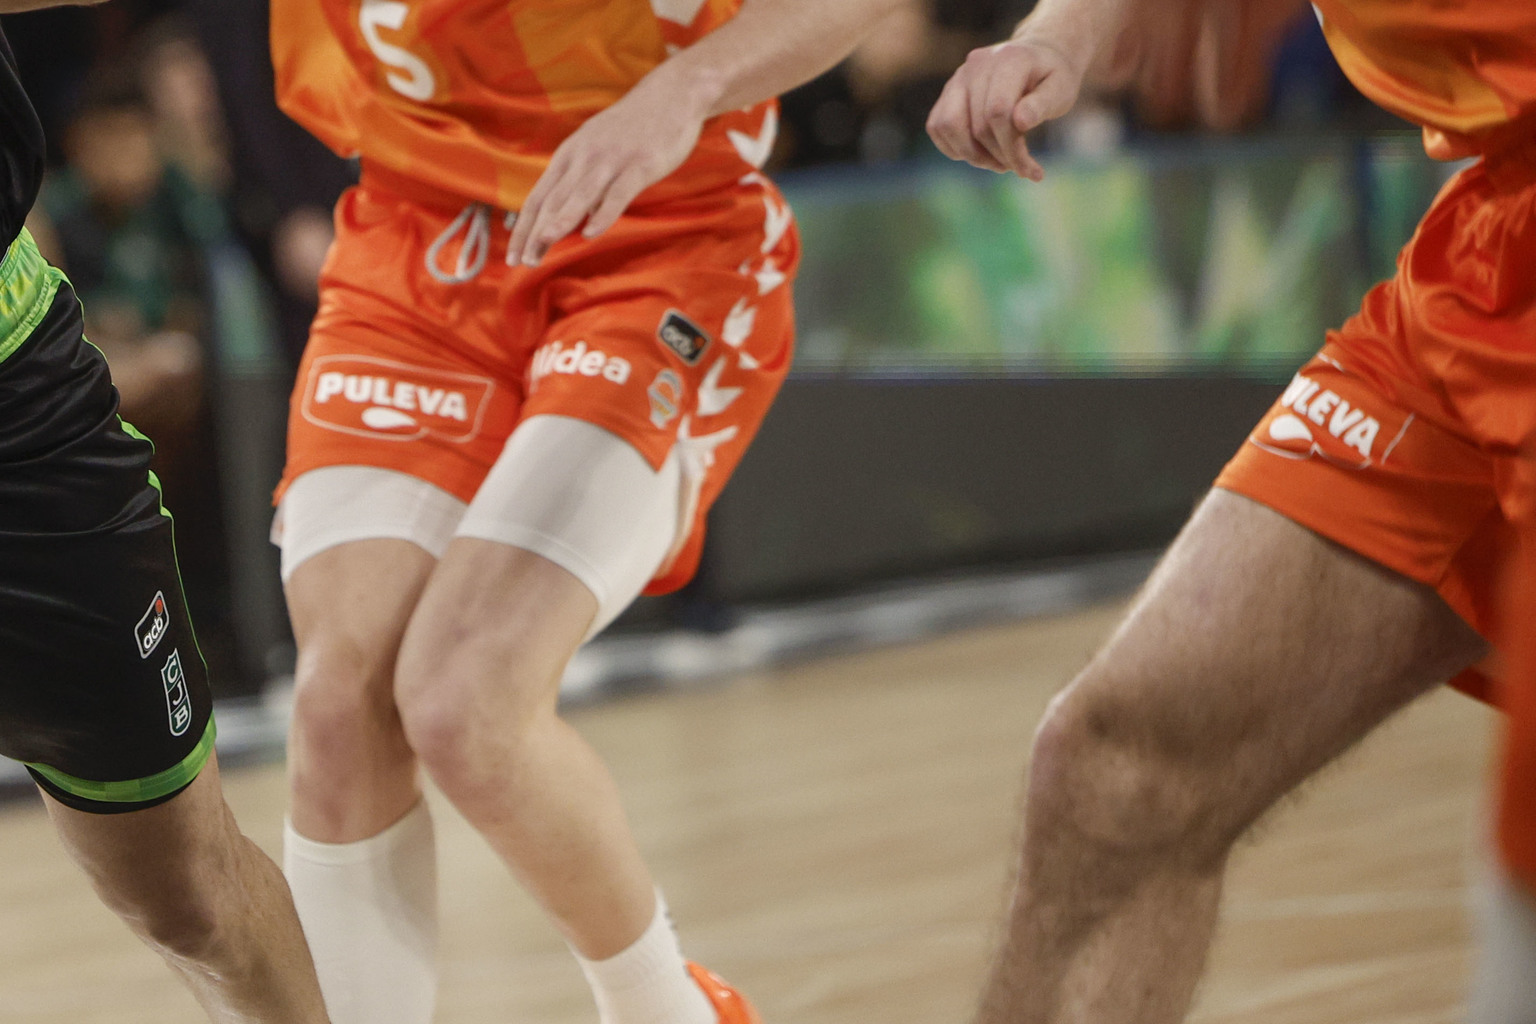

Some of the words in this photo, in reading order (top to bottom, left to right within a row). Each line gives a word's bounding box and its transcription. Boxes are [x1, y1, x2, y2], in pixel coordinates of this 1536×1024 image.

[315, 372, 468, 421] PULEVA
[1280, 372, 1380, 457] ULEVA
[143, 616, 164, 650] acb
